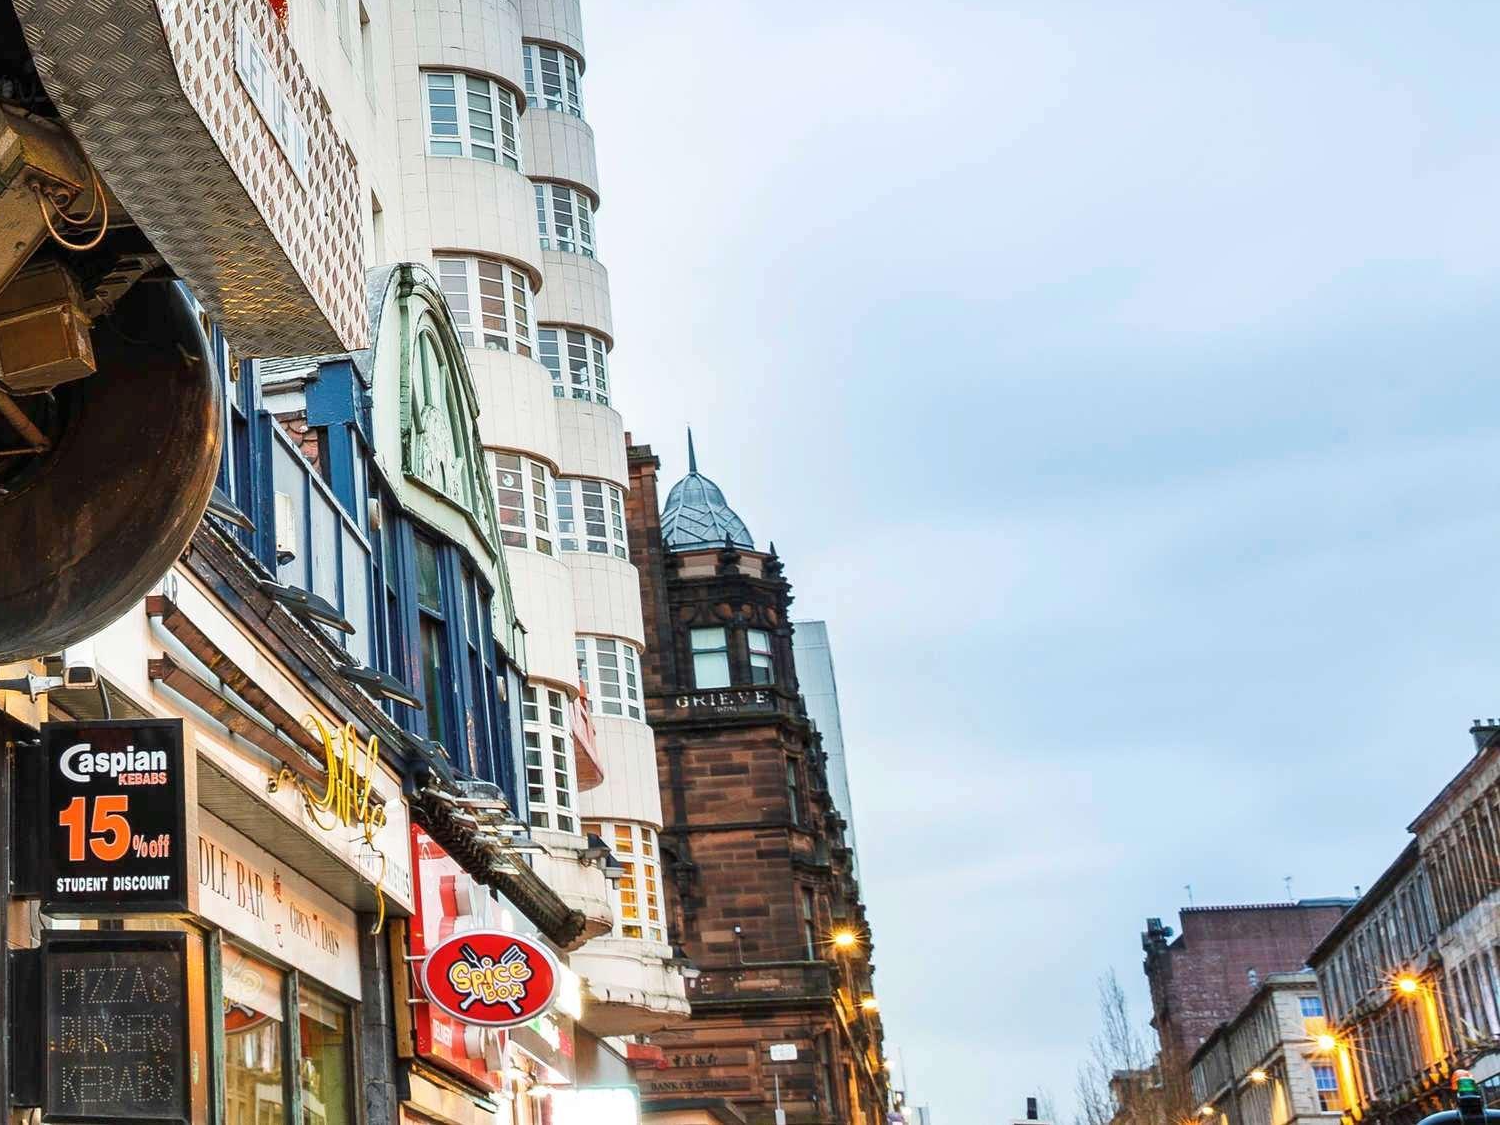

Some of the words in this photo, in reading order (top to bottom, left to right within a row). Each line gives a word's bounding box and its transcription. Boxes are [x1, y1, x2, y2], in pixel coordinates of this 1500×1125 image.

[59, 743, 168, 783] Caspian
[118, 772, 168, 786] KEBABS
[56, 877, 108, 893] STUDENT
[113, 875, 170, 891] DISCOUNT
[235, 860, 265, 922] BAR
[288, 901, 312, 944] OPEN
[320, 920, 340, 956] DAYS
[61, 966, 170, 1005] PIZZAS
[450, 957, 531, 996] Spice
[483, 979, 525, 1002] Box
[61, 1013, 173, 1054] BURGERS
[62, 1064, 173, 1103] KEBABS
[651, 1081, 676, 1091] BANK
